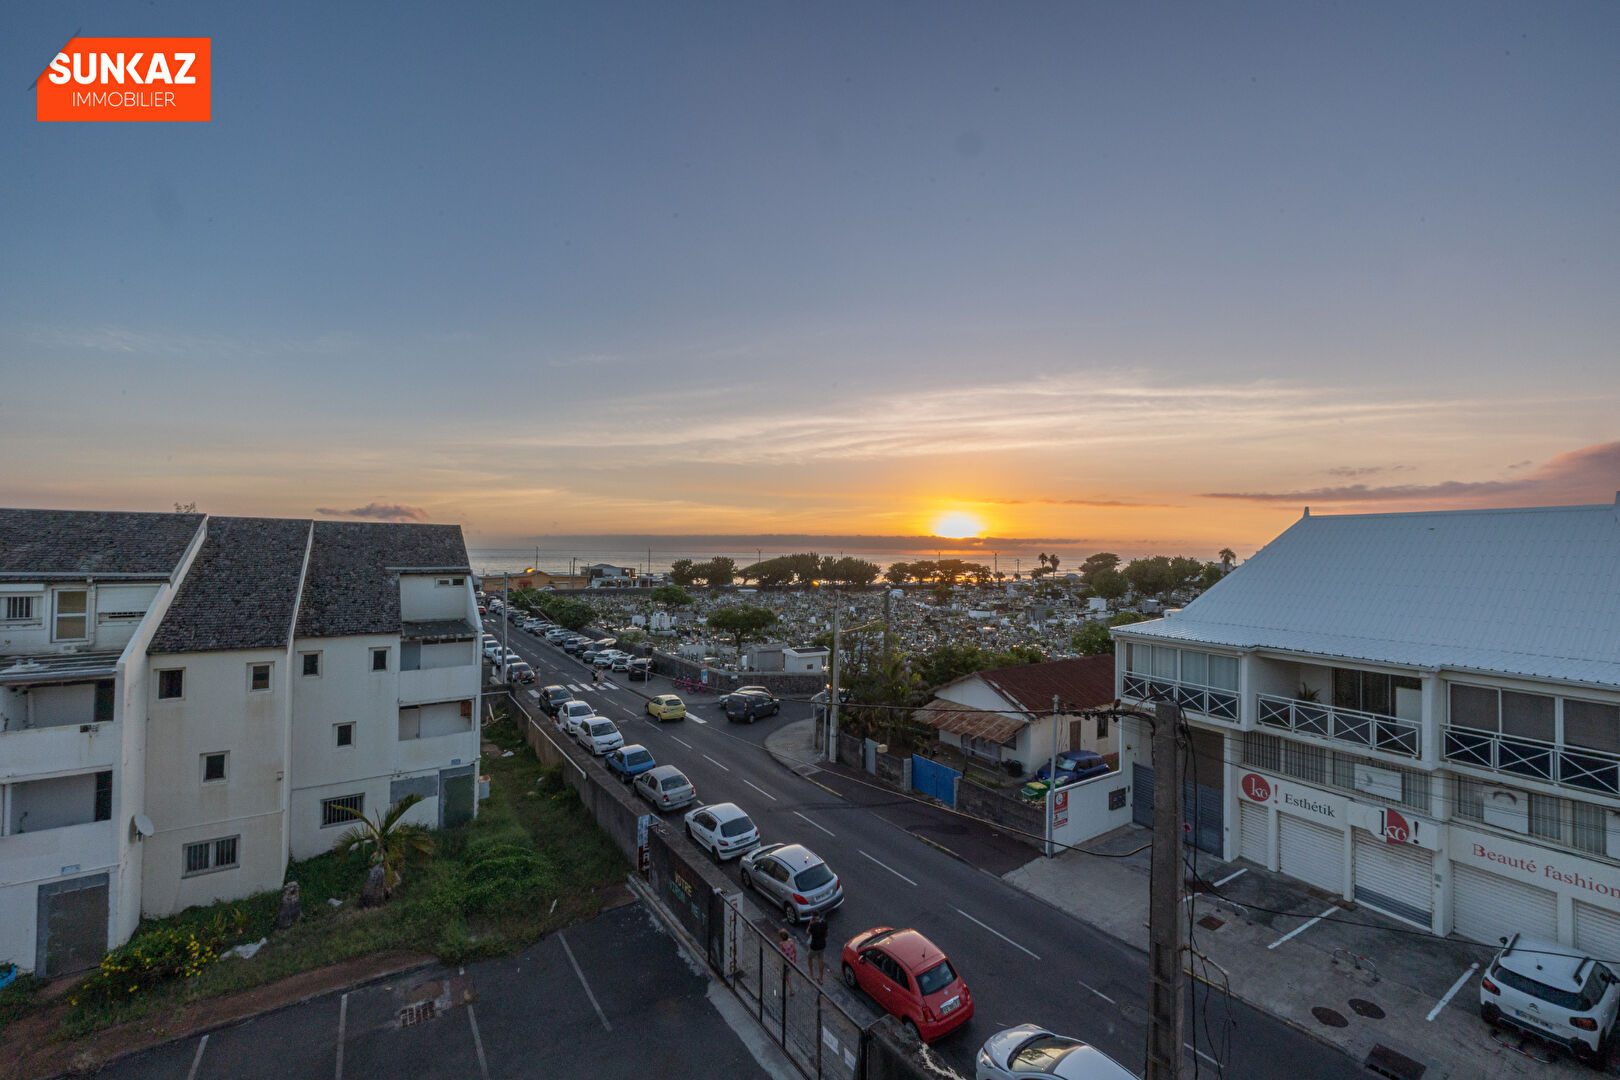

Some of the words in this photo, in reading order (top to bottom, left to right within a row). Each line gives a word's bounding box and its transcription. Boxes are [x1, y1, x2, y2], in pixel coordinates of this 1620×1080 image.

[1284, 793, 1336, 818] Esthétik
[1472, 843, 1537, 873] Beauté
[1544, 865, 1620, 898] fashion
